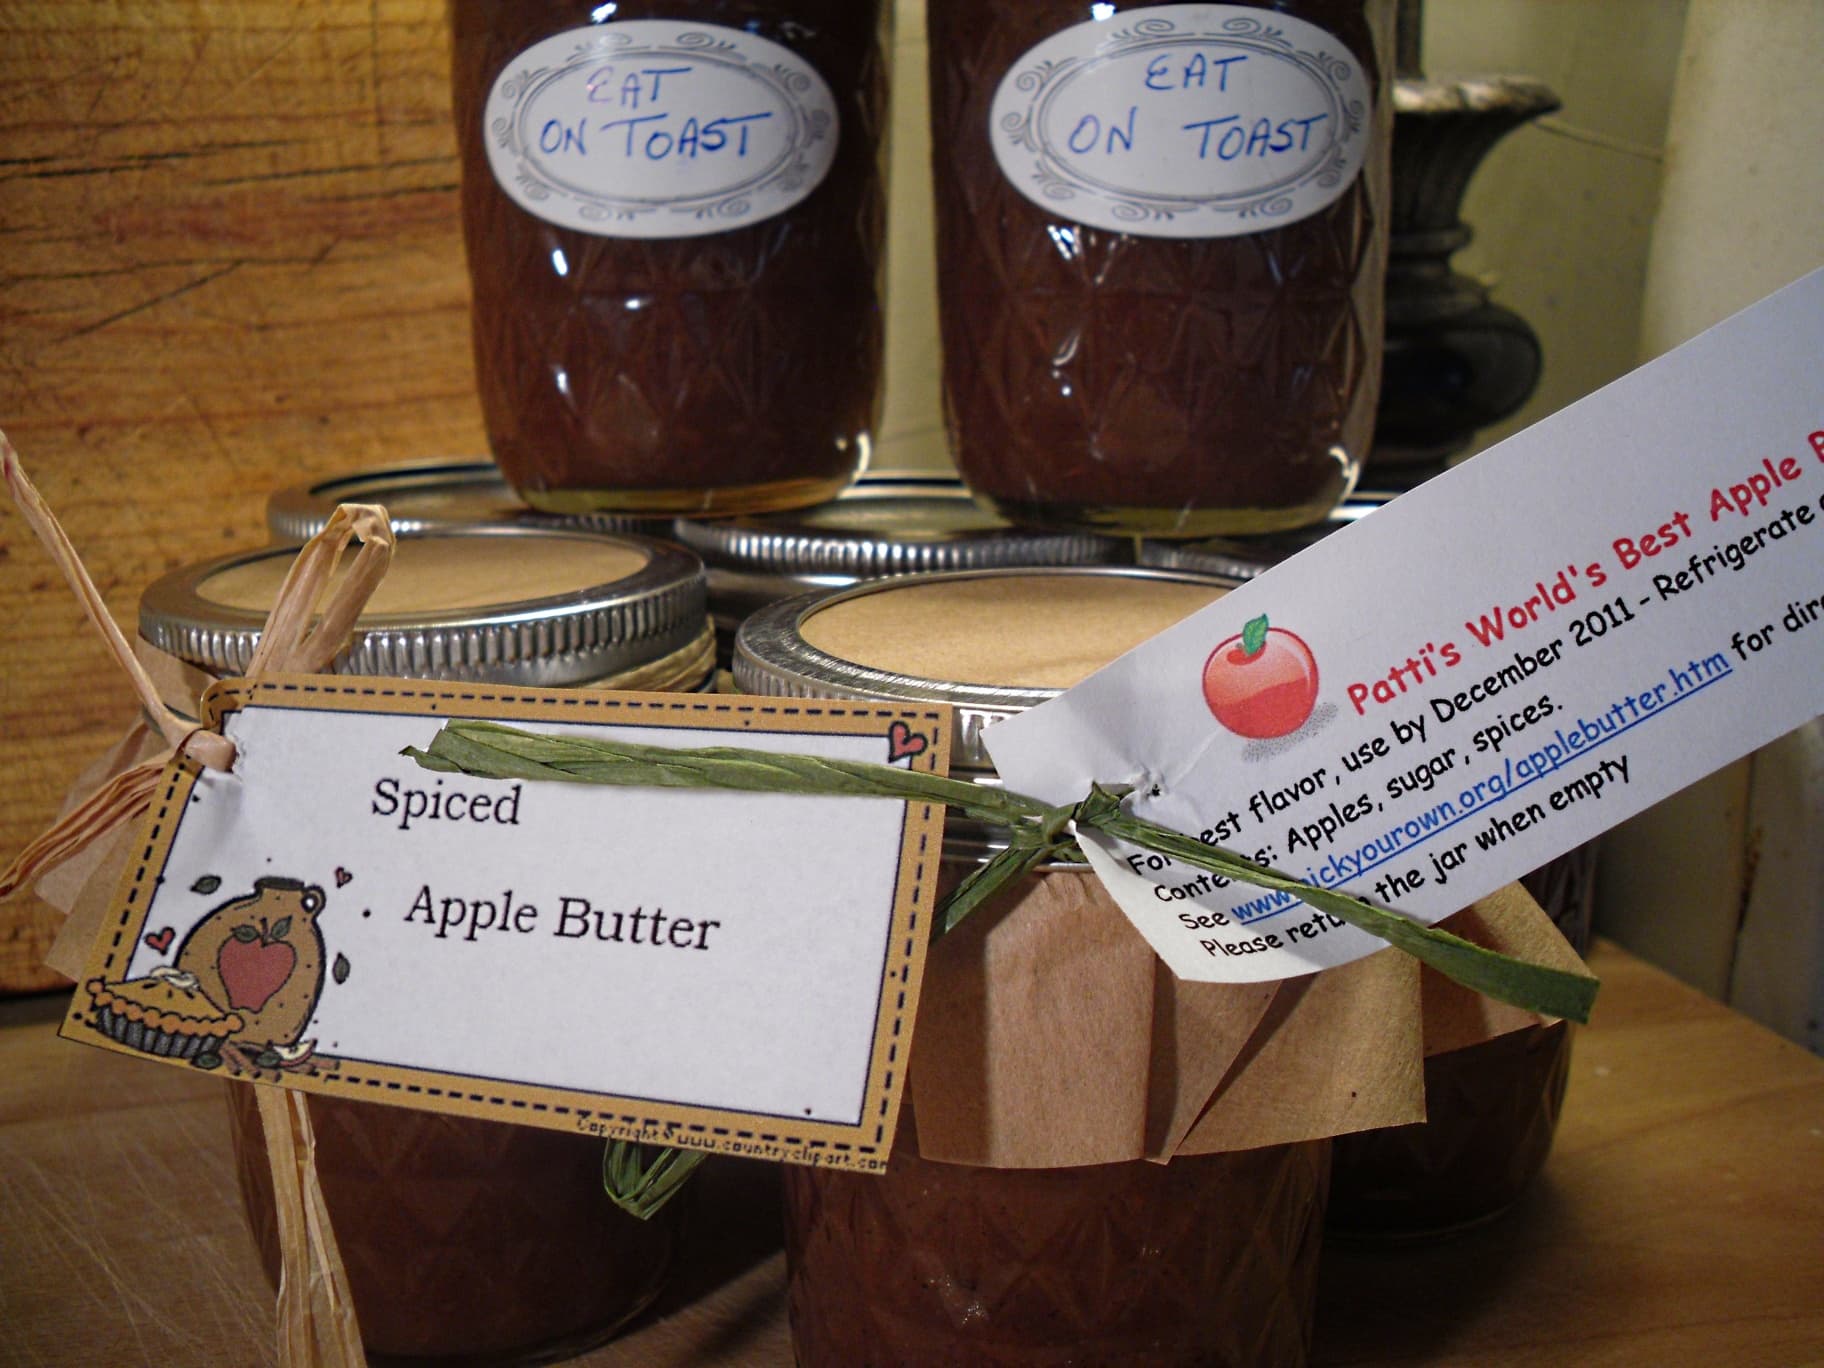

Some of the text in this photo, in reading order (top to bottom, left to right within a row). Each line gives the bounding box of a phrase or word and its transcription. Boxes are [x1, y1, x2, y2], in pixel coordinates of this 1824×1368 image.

[586, 66, 693, 109] EAT
[1145, 53, 1249, 92] EAT
[539, 112, 774, 160] ON TOAST
[1068, 105, 1329, 160] ON TOAST
[1347, 641, 1462, 716] Patti's
[1465, 563, 1608, 648] World's
[1612, 511, 1692, 570] Best
[1709, 457, 1803, 521] Apple
[1178, 811, 1242, 856] est
[1341, 737, 1391, 772] use
[1390, 714, 1427, 744] by
[1429, 639, 1563, 724] December
[1568, 596, 1636, 647] 2011
[1652, 505, 1816, 602] Refrigerate
[1178, 594, 1824, 930] See wwwickyourown.org/applebutter.htm for dir
[371, 778, 523, 831] Spiced
[1153, 844, 1278, 902] Contes:
[1288, 793, 1384, 854] Apples,
[1472, 694, 1564, 753] spices.
[1199, 754, 1630, 957] Please retu the jar when empty
[403, 884, 722, 951] Apple Butter
